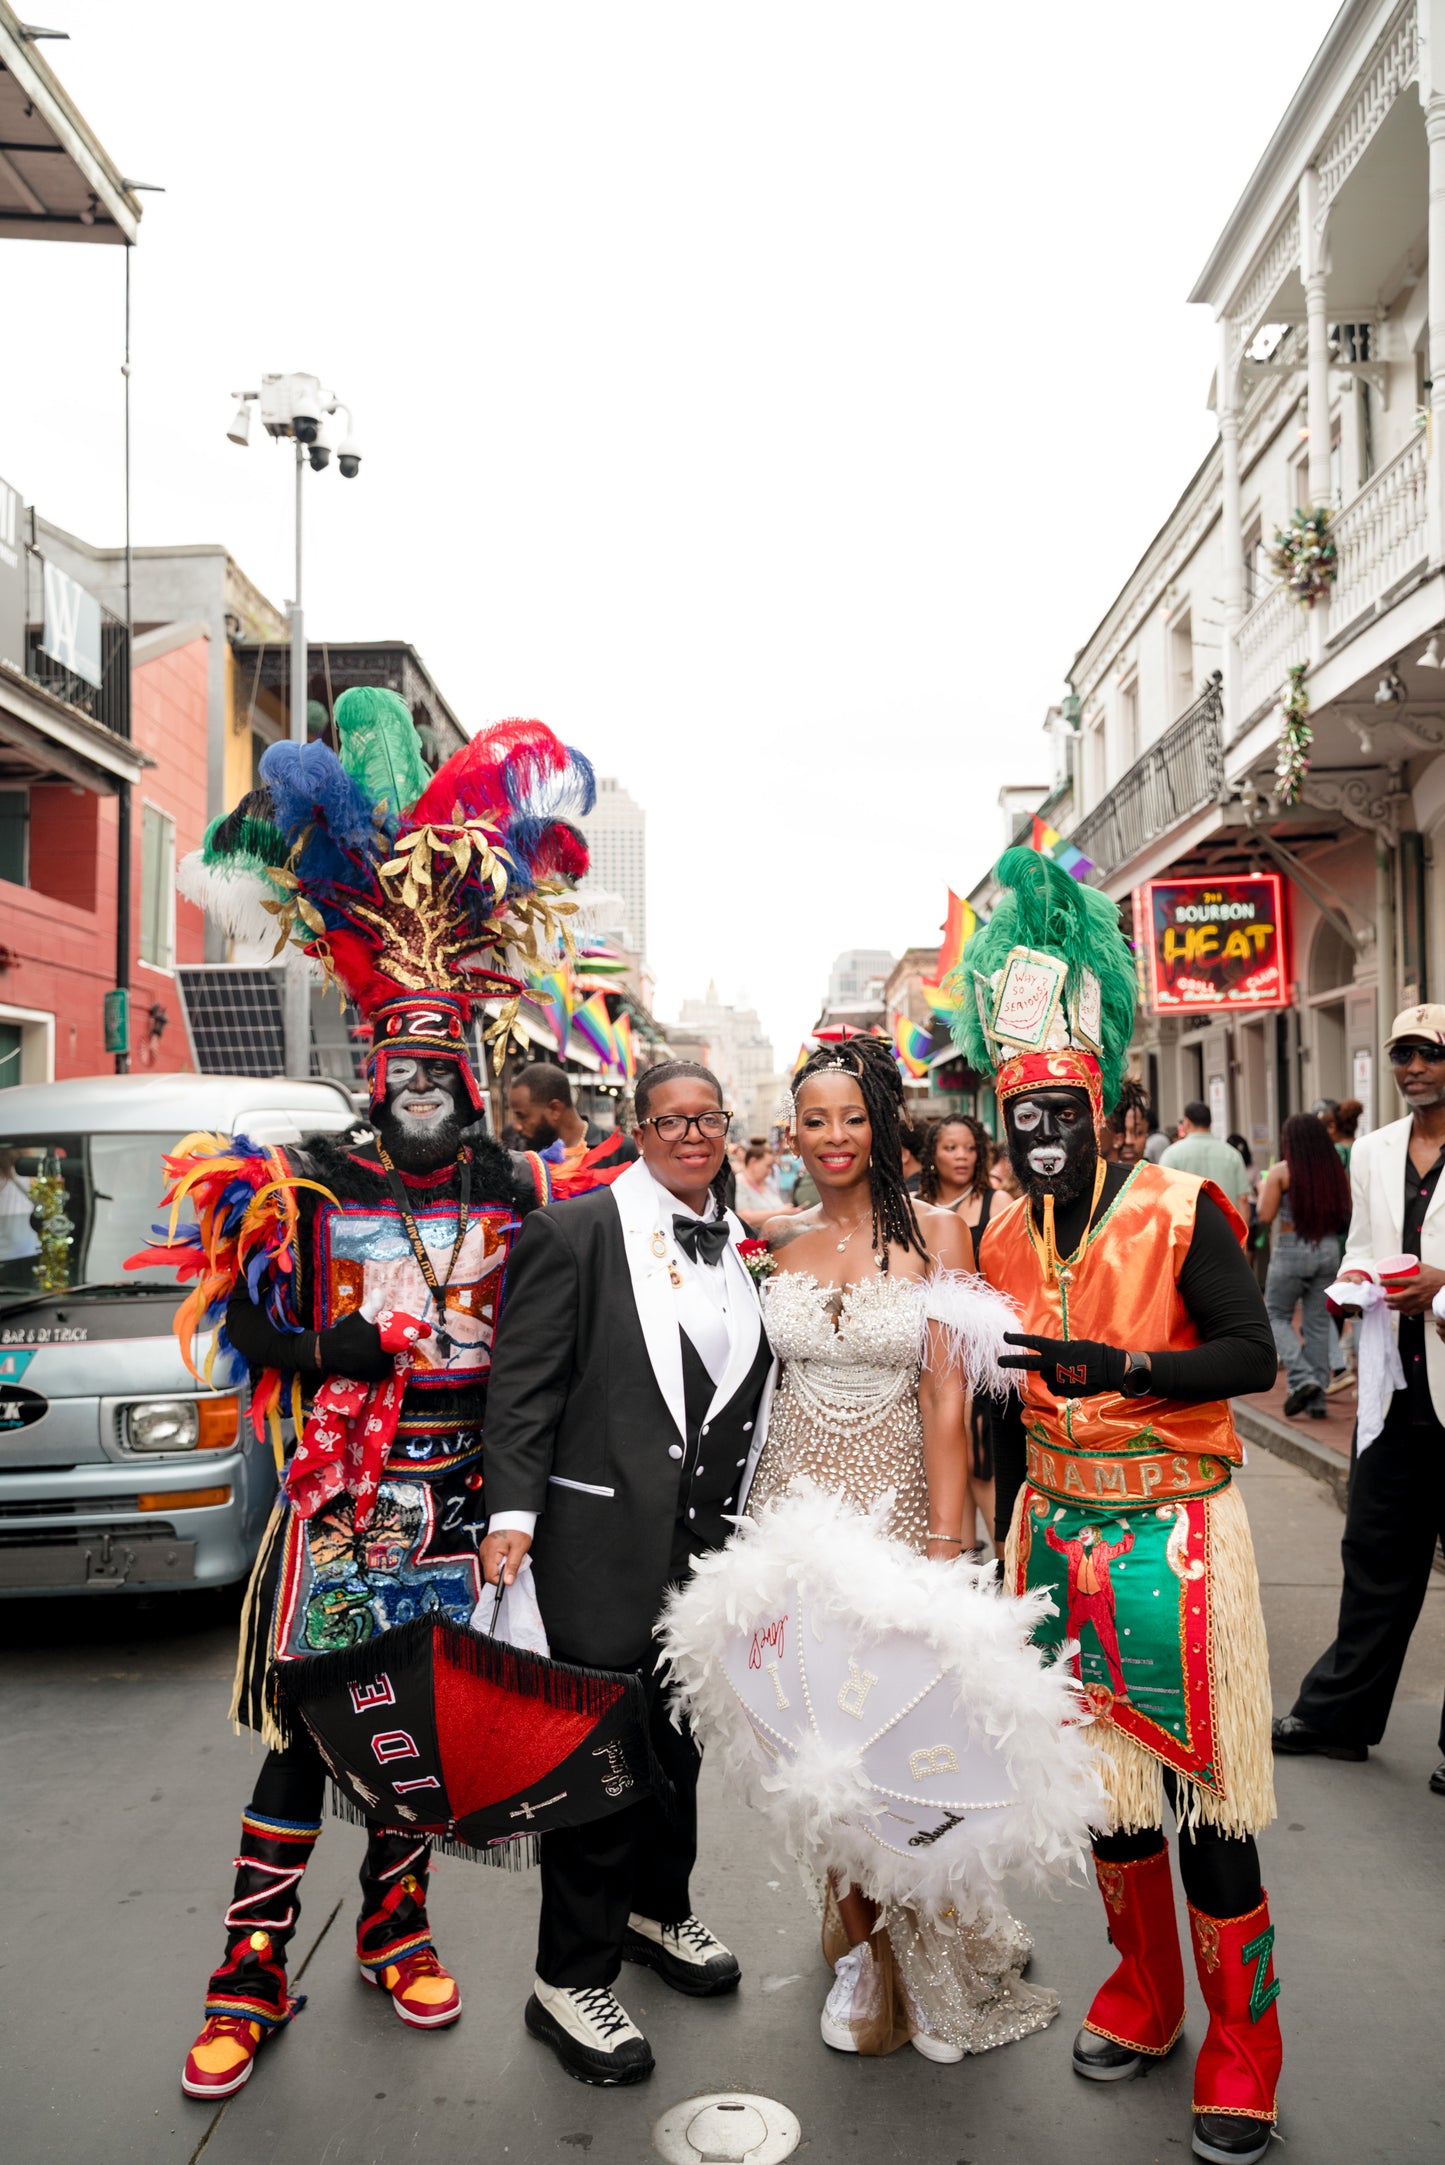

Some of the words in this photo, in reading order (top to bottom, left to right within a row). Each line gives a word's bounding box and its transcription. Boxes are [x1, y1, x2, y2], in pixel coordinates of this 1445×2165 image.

[1175, 903, 1255, 923] BOURBON
[1163, 924, 1275, 974] HEAT
[1015, 970, 1038, 986] WHY
[1177, 977, 1217, 994] GRILL
[1013, 986, 1025, 996] SO
[406, 1010, 449, 1037] Z
[380, 1150, 395, 1171] ZULU
[460, 1203, 469, 1230] ZULU
[407, 1226, 419, 1240] All
[421, 1261, 438, 1288] ZULU
[2, 1328, 25, 1344] BAR
[53, 1327, 88, 1342] TRUCK
[1029, 1446, 1191, 1498] TRAMPS
[908, 1811, 966, 1847] Blessed
[1242, 1924, 1281, 2025] Z
